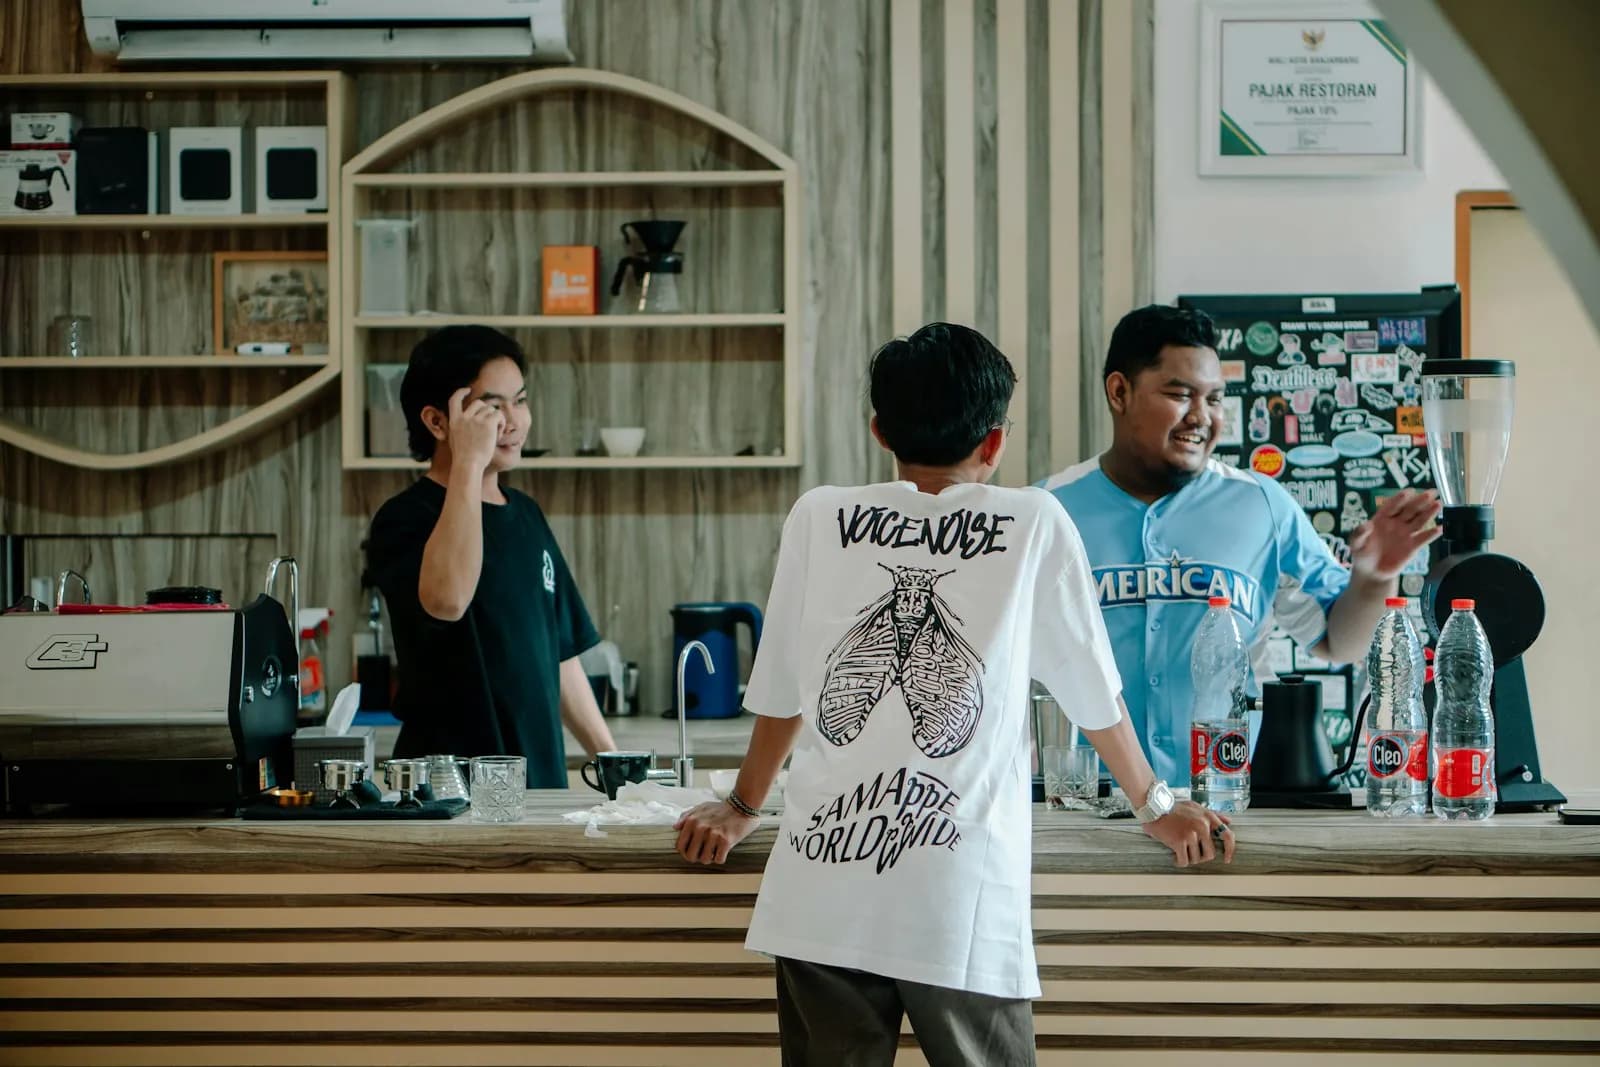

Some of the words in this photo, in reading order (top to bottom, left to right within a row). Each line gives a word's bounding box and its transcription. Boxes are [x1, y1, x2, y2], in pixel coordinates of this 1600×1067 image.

[1249, 83, 1294, 97] PAJAK
[1299, 83, 1377, 97] RESTORAN
[1287, 106, 1315, 115] PAJAK
[1253, 365, 1337, 391] Deathless
[838, 504, 1015, 560] VOICENOISE
[1091, 566, 1254, 612] MERICAN
[1221, 742, 1247, 761] Cleo
[1374, 745, 1401, 765] Cleo
